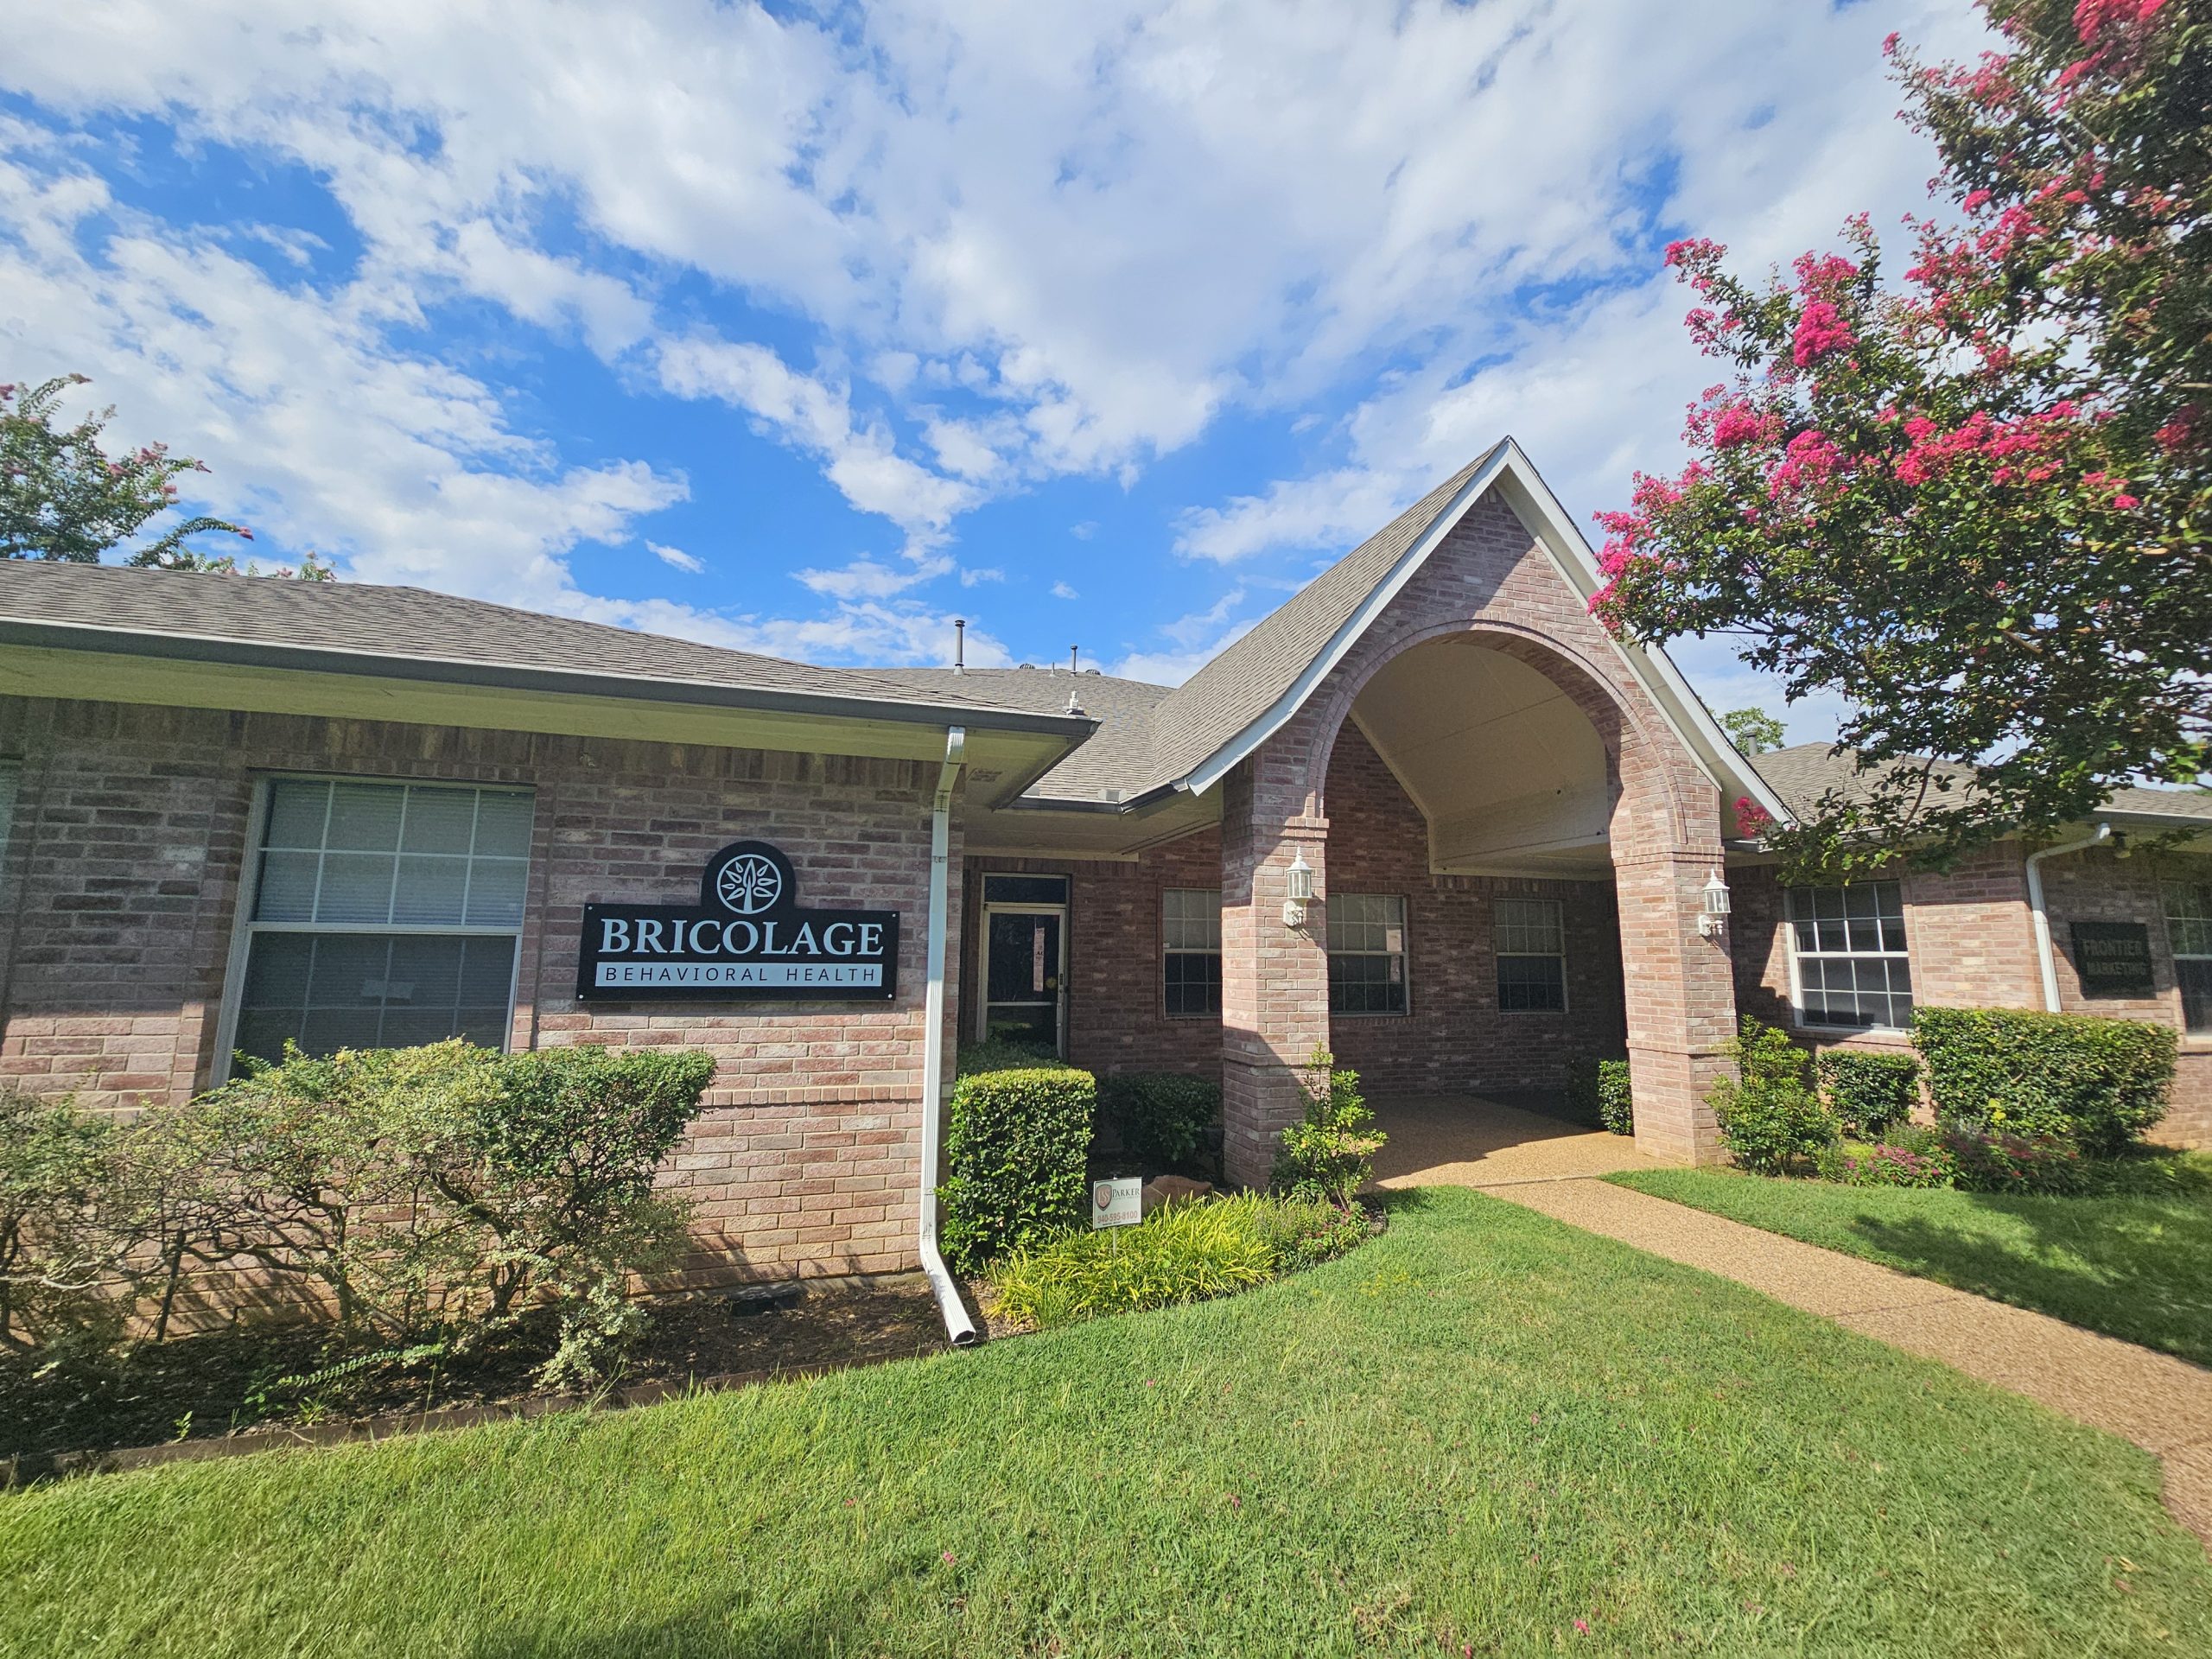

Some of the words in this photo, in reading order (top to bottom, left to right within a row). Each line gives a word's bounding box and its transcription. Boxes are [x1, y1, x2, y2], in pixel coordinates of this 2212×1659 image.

[598, 918, 884, 956] BRICOLAGE
[606, 966, 767, 982] BEHAVIORAL
[786, 968, 875, 982] HEALTH
[1112, 1188, 1140, 1198] PARKER
